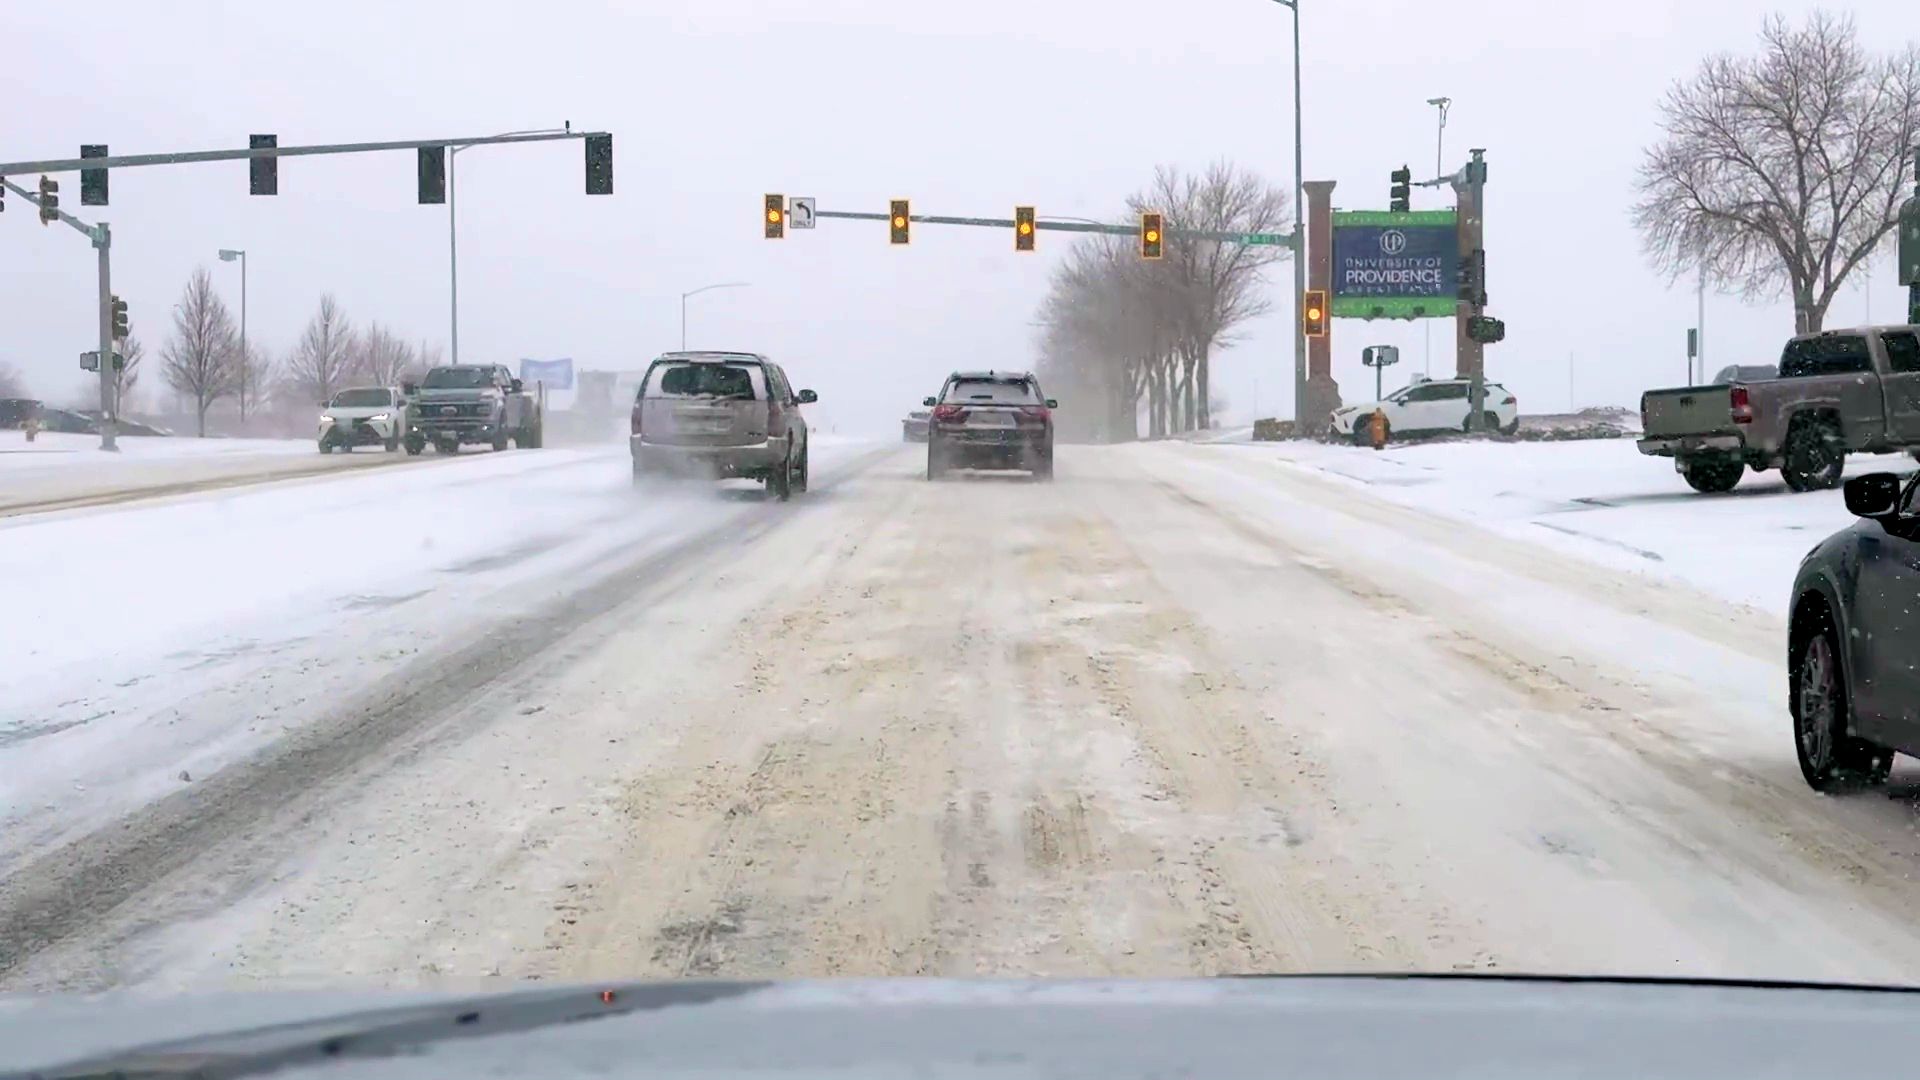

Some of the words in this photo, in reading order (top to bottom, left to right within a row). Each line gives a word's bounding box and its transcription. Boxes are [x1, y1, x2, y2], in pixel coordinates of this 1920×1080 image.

[1345, 258, 1421, 268] UNIVERSITY
[1426, 258, 1442, 268] OF
[1345, 270, 1442, 283] PROVIDENCE
